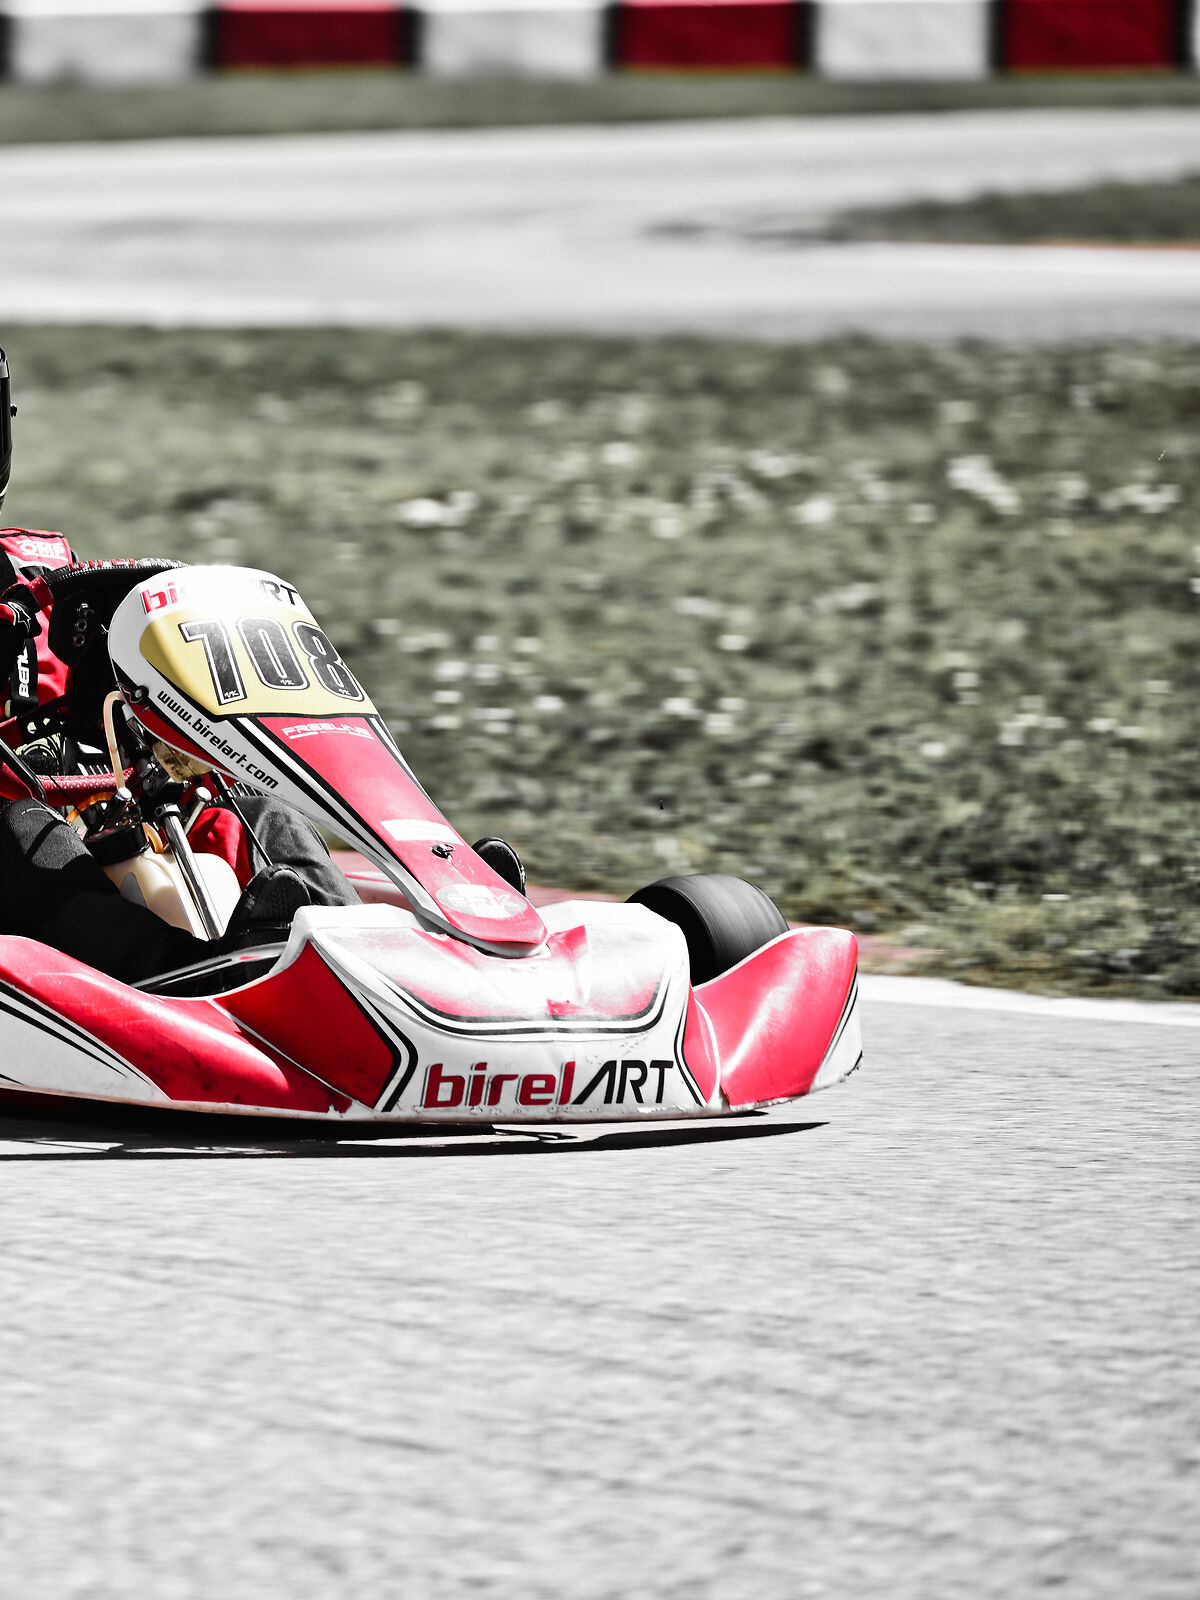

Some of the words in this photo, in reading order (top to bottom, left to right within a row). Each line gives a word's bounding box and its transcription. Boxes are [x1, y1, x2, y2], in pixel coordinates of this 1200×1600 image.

[20, 542, 66, 558] OMP
[178, 617, 364, 706] 108
[157, 690, 279, 789] www.birelart.com
